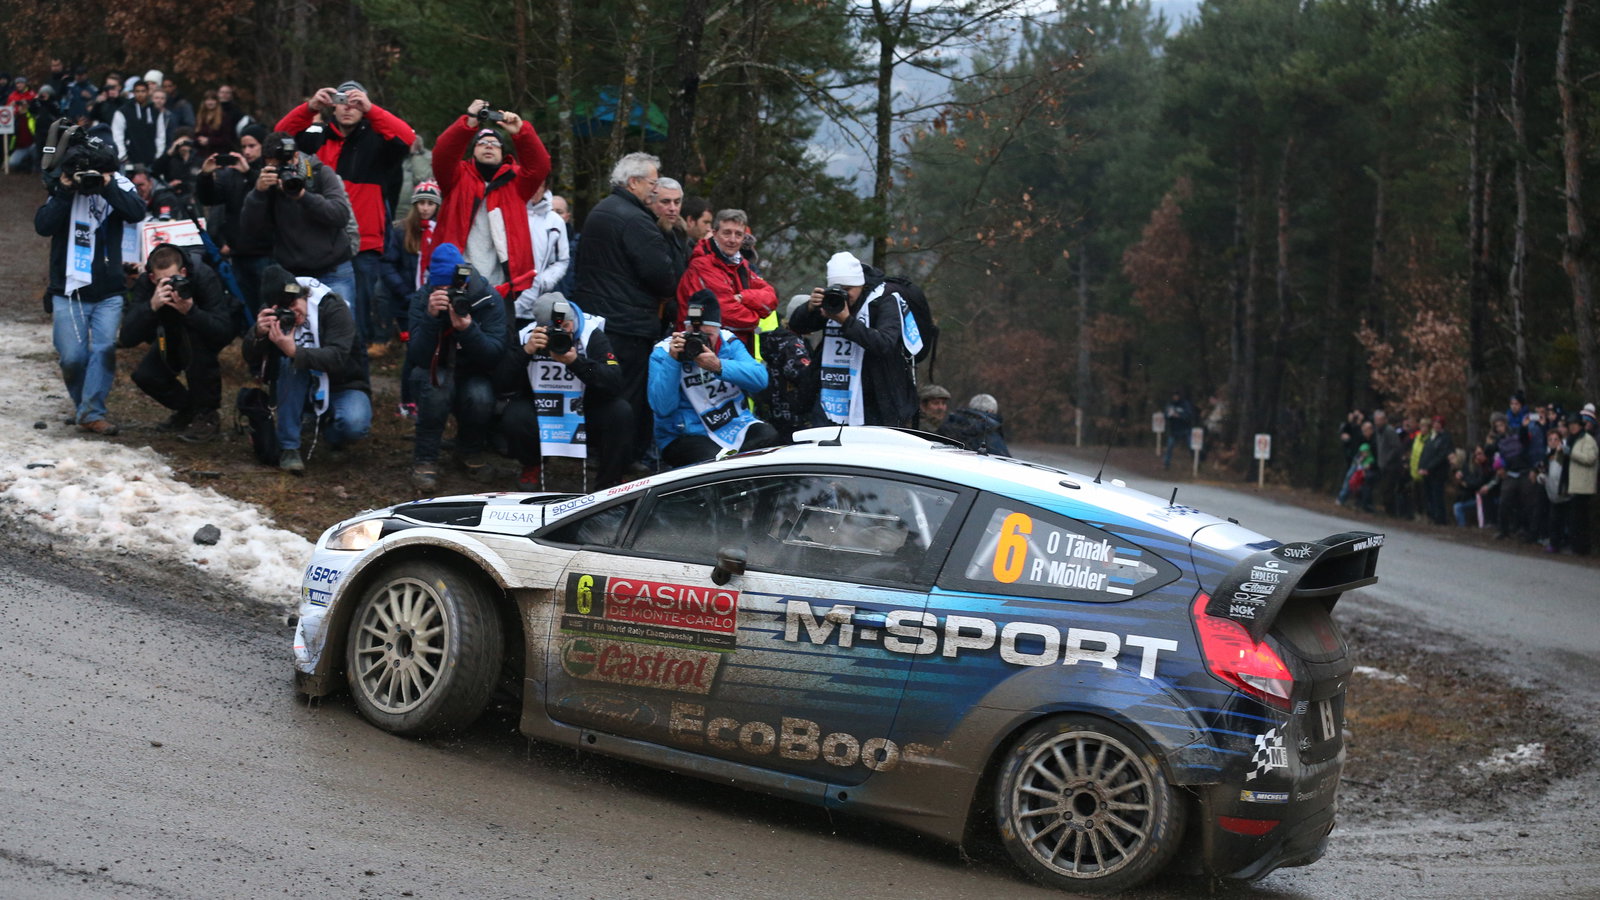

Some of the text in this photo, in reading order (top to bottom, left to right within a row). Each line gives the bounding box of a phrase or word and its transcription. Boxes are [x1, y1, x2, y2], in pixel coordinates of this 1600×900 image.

[540, 365, 575, 381] 228
[820, 370, 851, 382] Lexar
[705, 381, 735, 399] 24
[552, 494, 595, 516] sparco
[489, 510, 534, 523] PULSAR
[992, 512, 1033, 584] 6
[1046, 531, 1112, 563] O Tänak
[1284, 548, 1308, 558] SWP
[1030, 558, 1044, 581] R
[1250, 570, 1279, 582] ENDLESS
[577, 574, 735, 616] 6 CASINO
[610, 605, 733, 629] DE MONTE-CARLO
[1229, 604, 1256, 616] NGK
[607, 624, 624, 633] World
[628, 626, 644, 636] Rally
[646, 629, 694, 642] Championship
[784, 599, 1178, 680] M-SPORT
[598, 645, 709, 688] Castrol
[670, 700, 954, 772] EcoBoo
